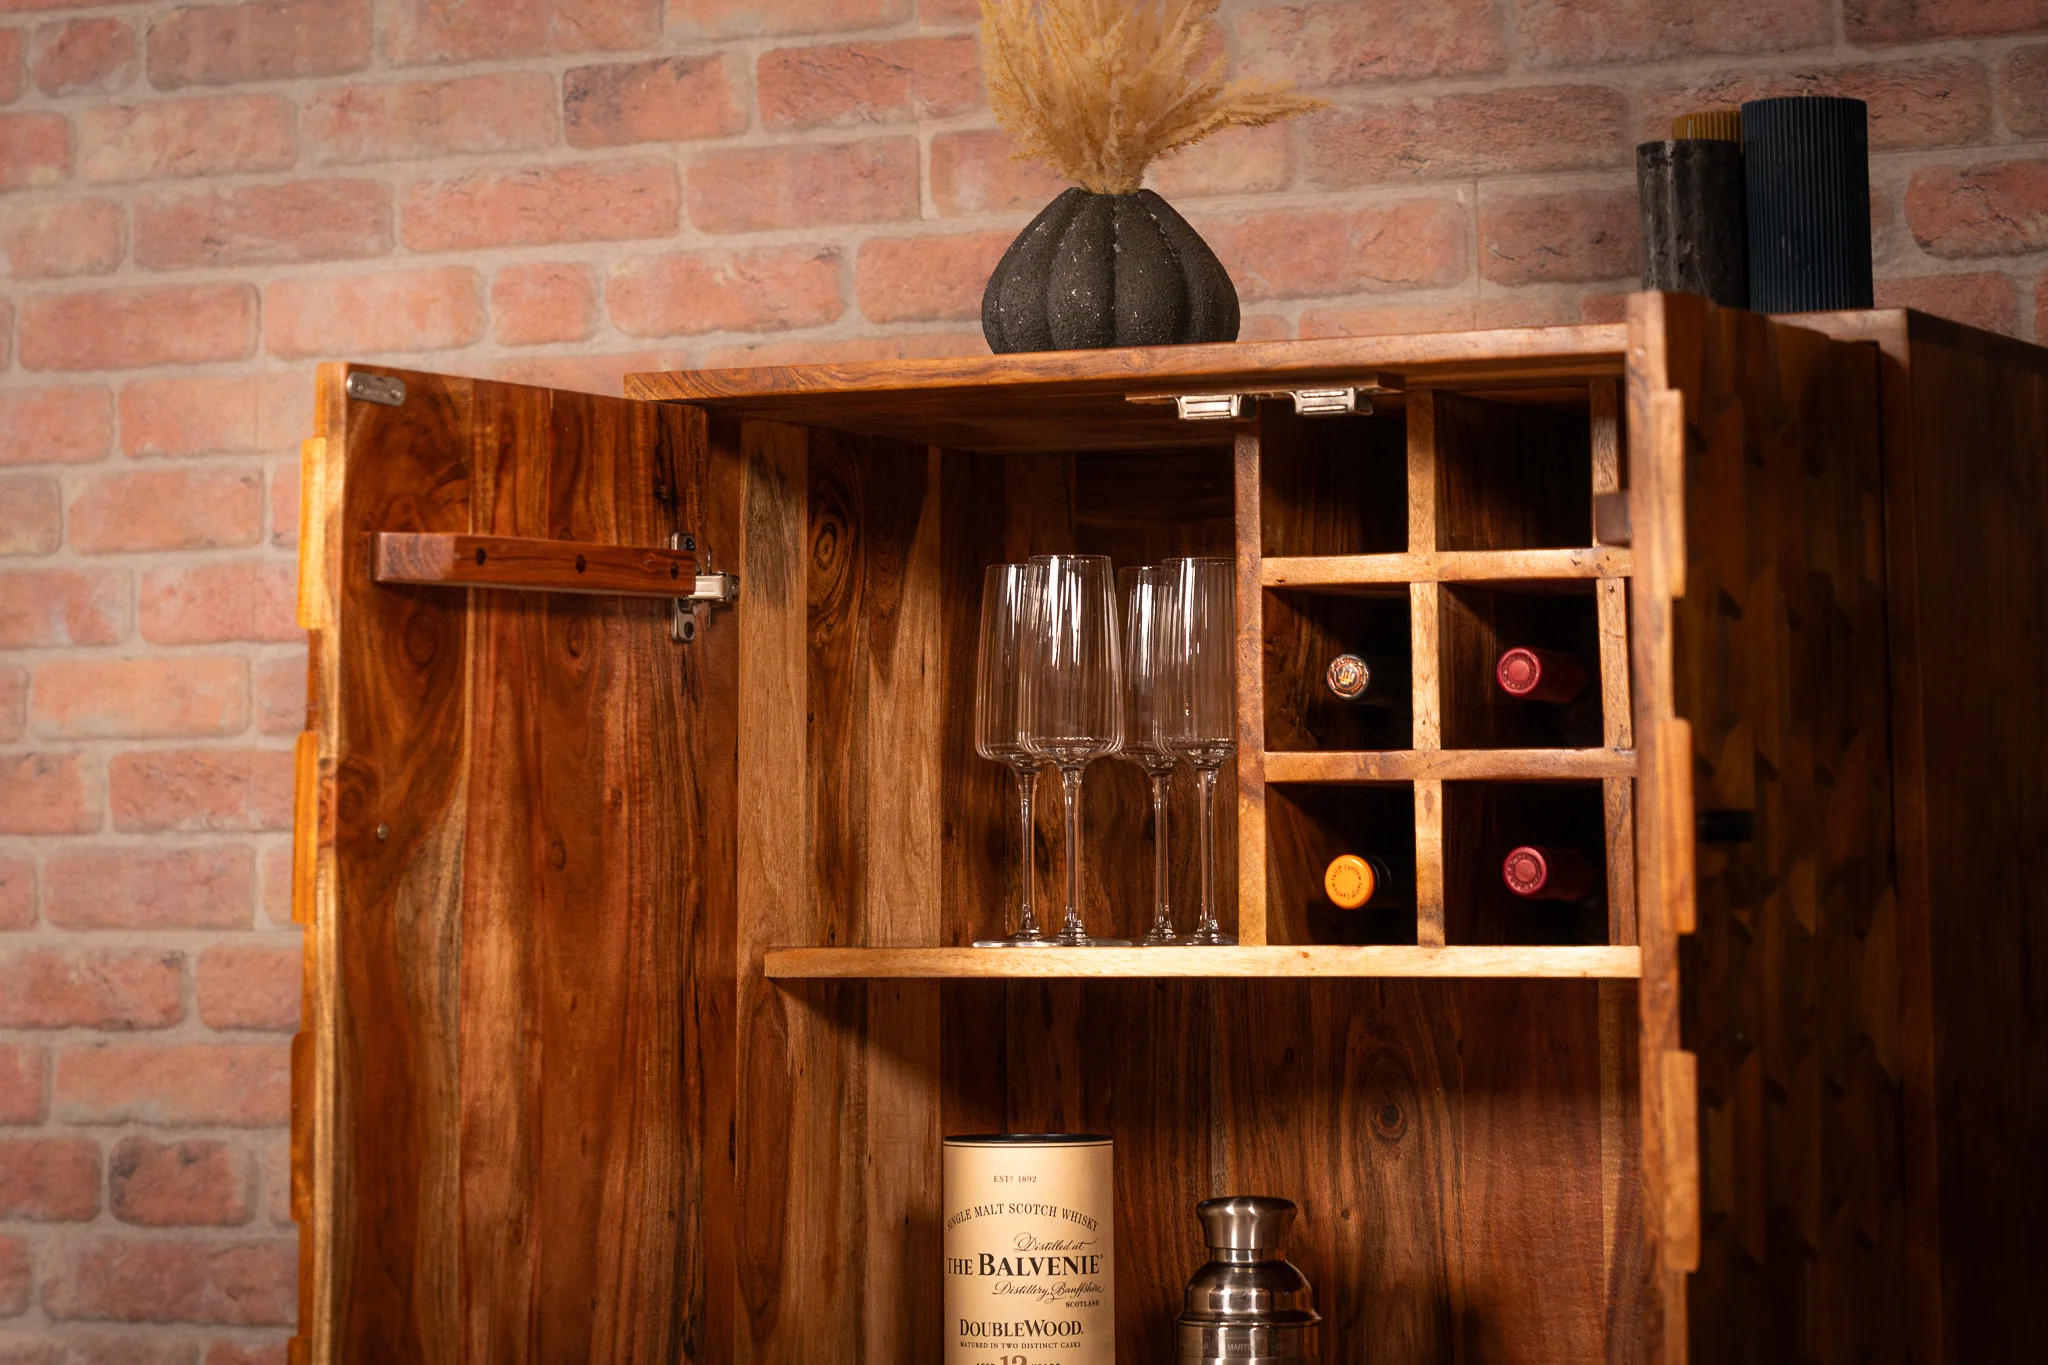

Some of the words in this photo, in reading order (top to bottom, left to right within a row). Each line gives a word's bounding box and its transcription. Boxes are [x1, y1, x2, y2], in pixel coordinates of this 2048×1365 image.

[1018, 1175, 1037, 1183] 1892
[947, 1208, 972, 1232] SINGLE
[974, 1203, 1005, 1218] MALT
[1008, 1203, 1057, 1217] SCOTCH
[1062, 1208, 1099, 1232] WHISKY
[1013, 1232, 1073, 1252] Distilled
[1072, 1237, 1098, 1251] at
[946, 1257, 973, 1276] THE
[1065, 1299, 1100, 1308] SCOTLAND
